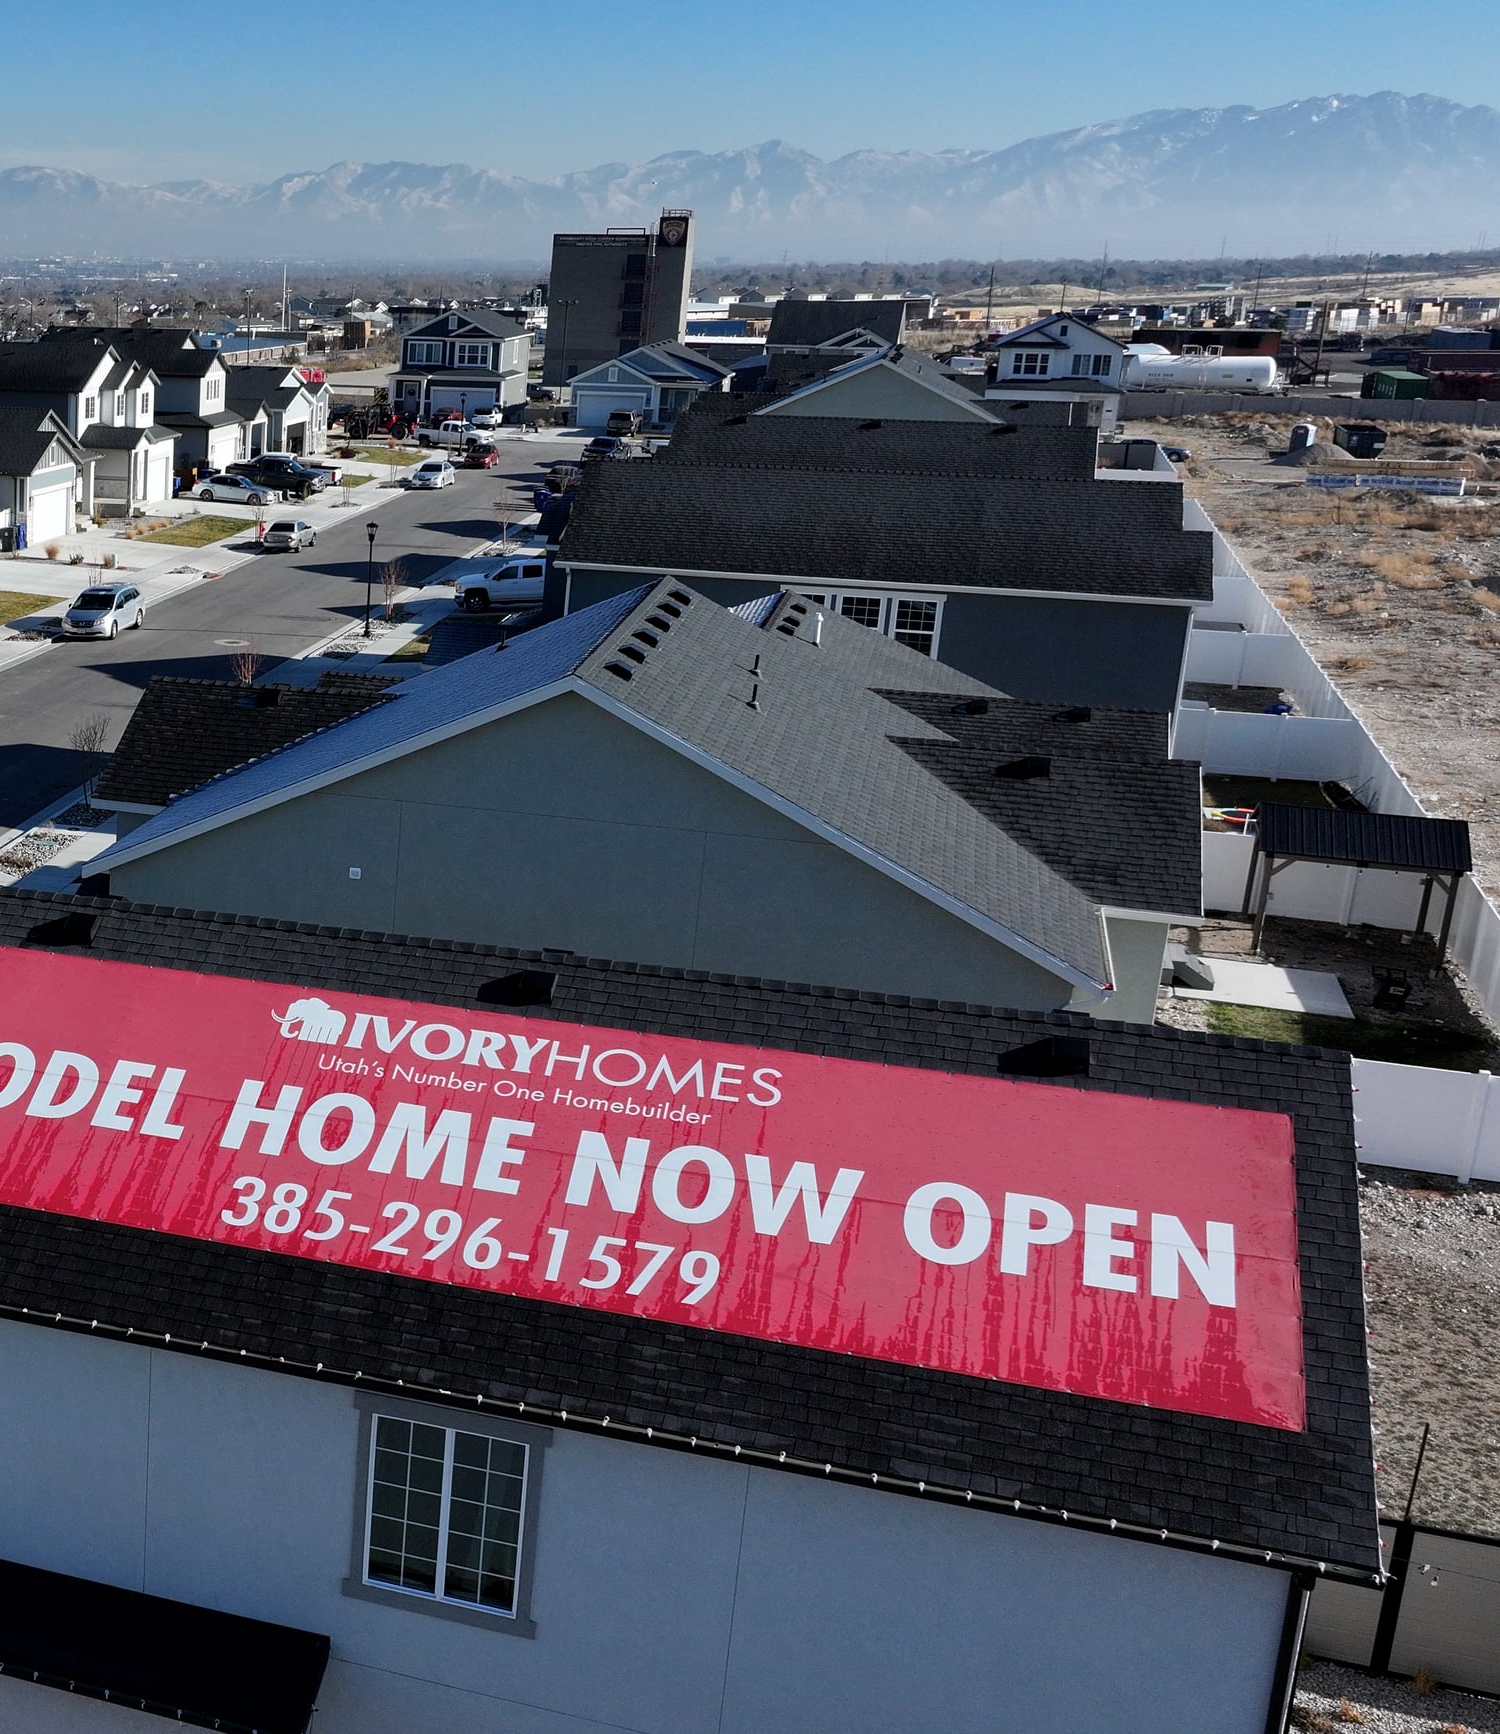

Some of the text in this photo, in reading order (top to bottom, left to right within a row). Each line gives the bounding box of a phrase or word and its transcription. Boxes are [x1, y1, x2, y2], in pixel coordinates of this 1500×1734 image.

[318, 1053, 711, 1125] Utah's Number One Homebuilder
[344, 1013, 783, 1108] IVORYHOMES
[219, 1079, 536, 1196] HOME
[565, 1129, 866, 1246] NOW
[903, 1181, 1237, 1309] OPEN
[221, 1175, 721, 1305] 385-296-1579
